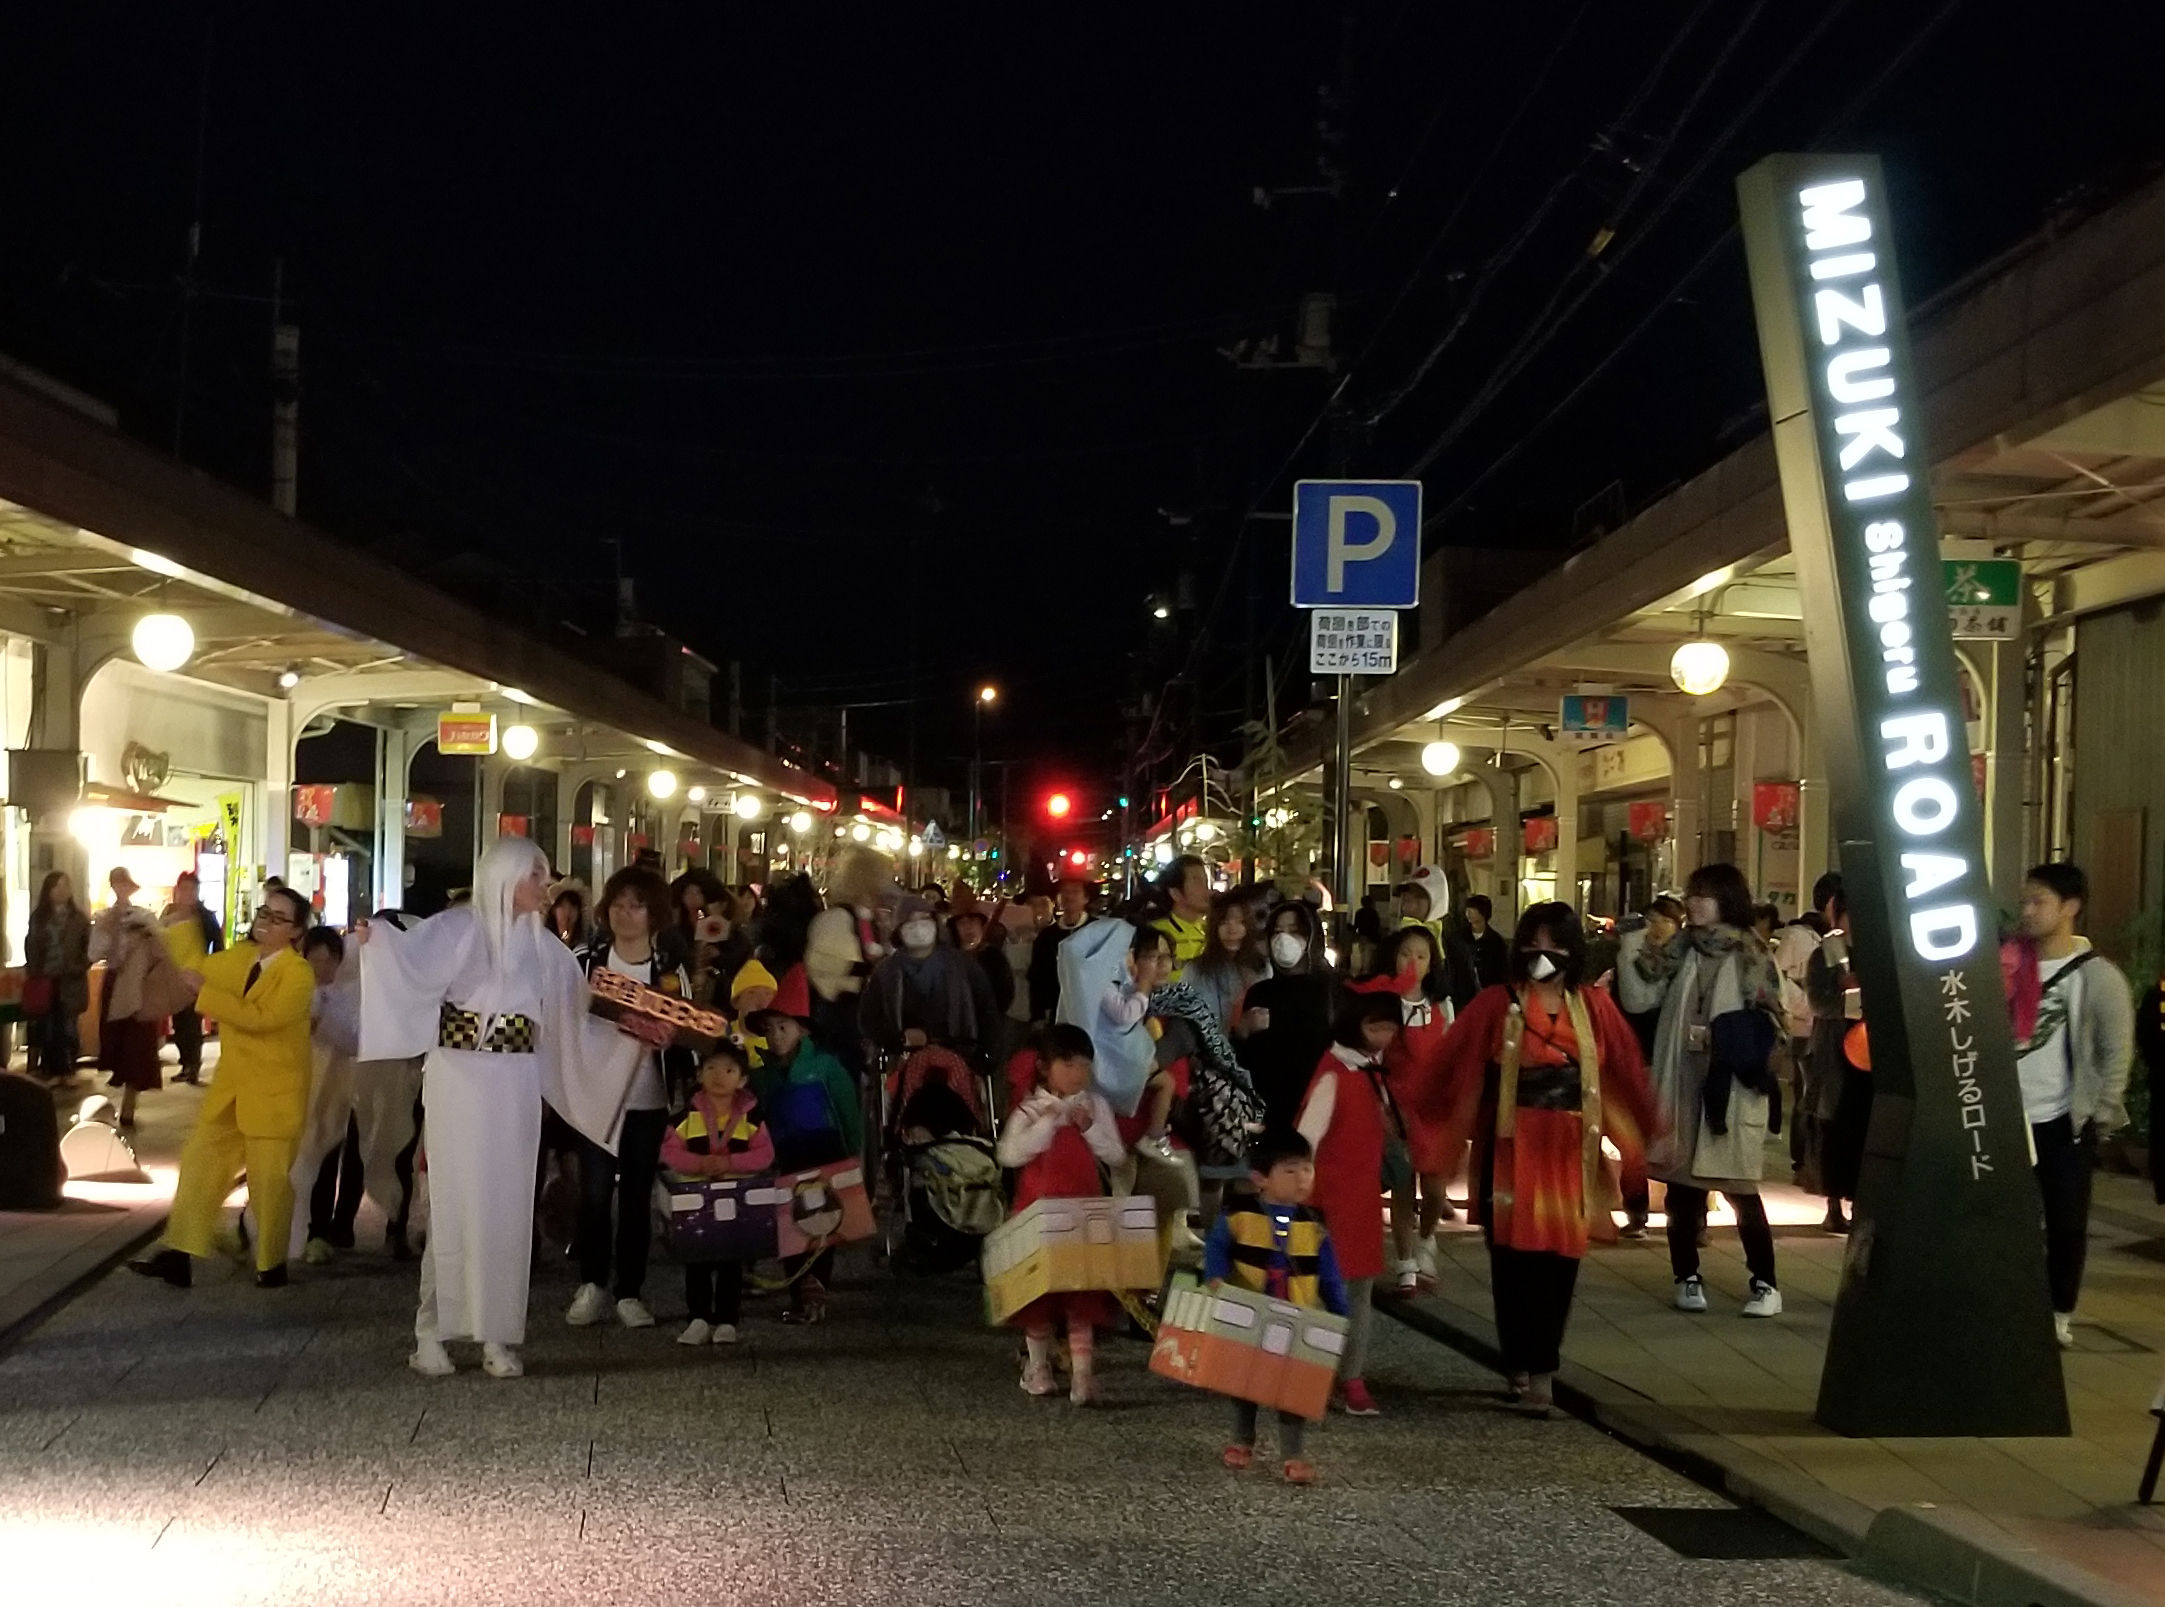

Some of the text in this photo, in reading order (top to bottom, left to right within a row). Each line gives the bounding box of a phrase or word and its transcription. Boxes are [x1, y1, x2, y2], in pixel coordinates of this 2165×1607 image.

[1326, 495, 1397, 594] P
[1798, 179, 1979, 962] MIZUKI Shigeru ROAD
[1939, 968, 1995, 1181] 水木しげるロード
